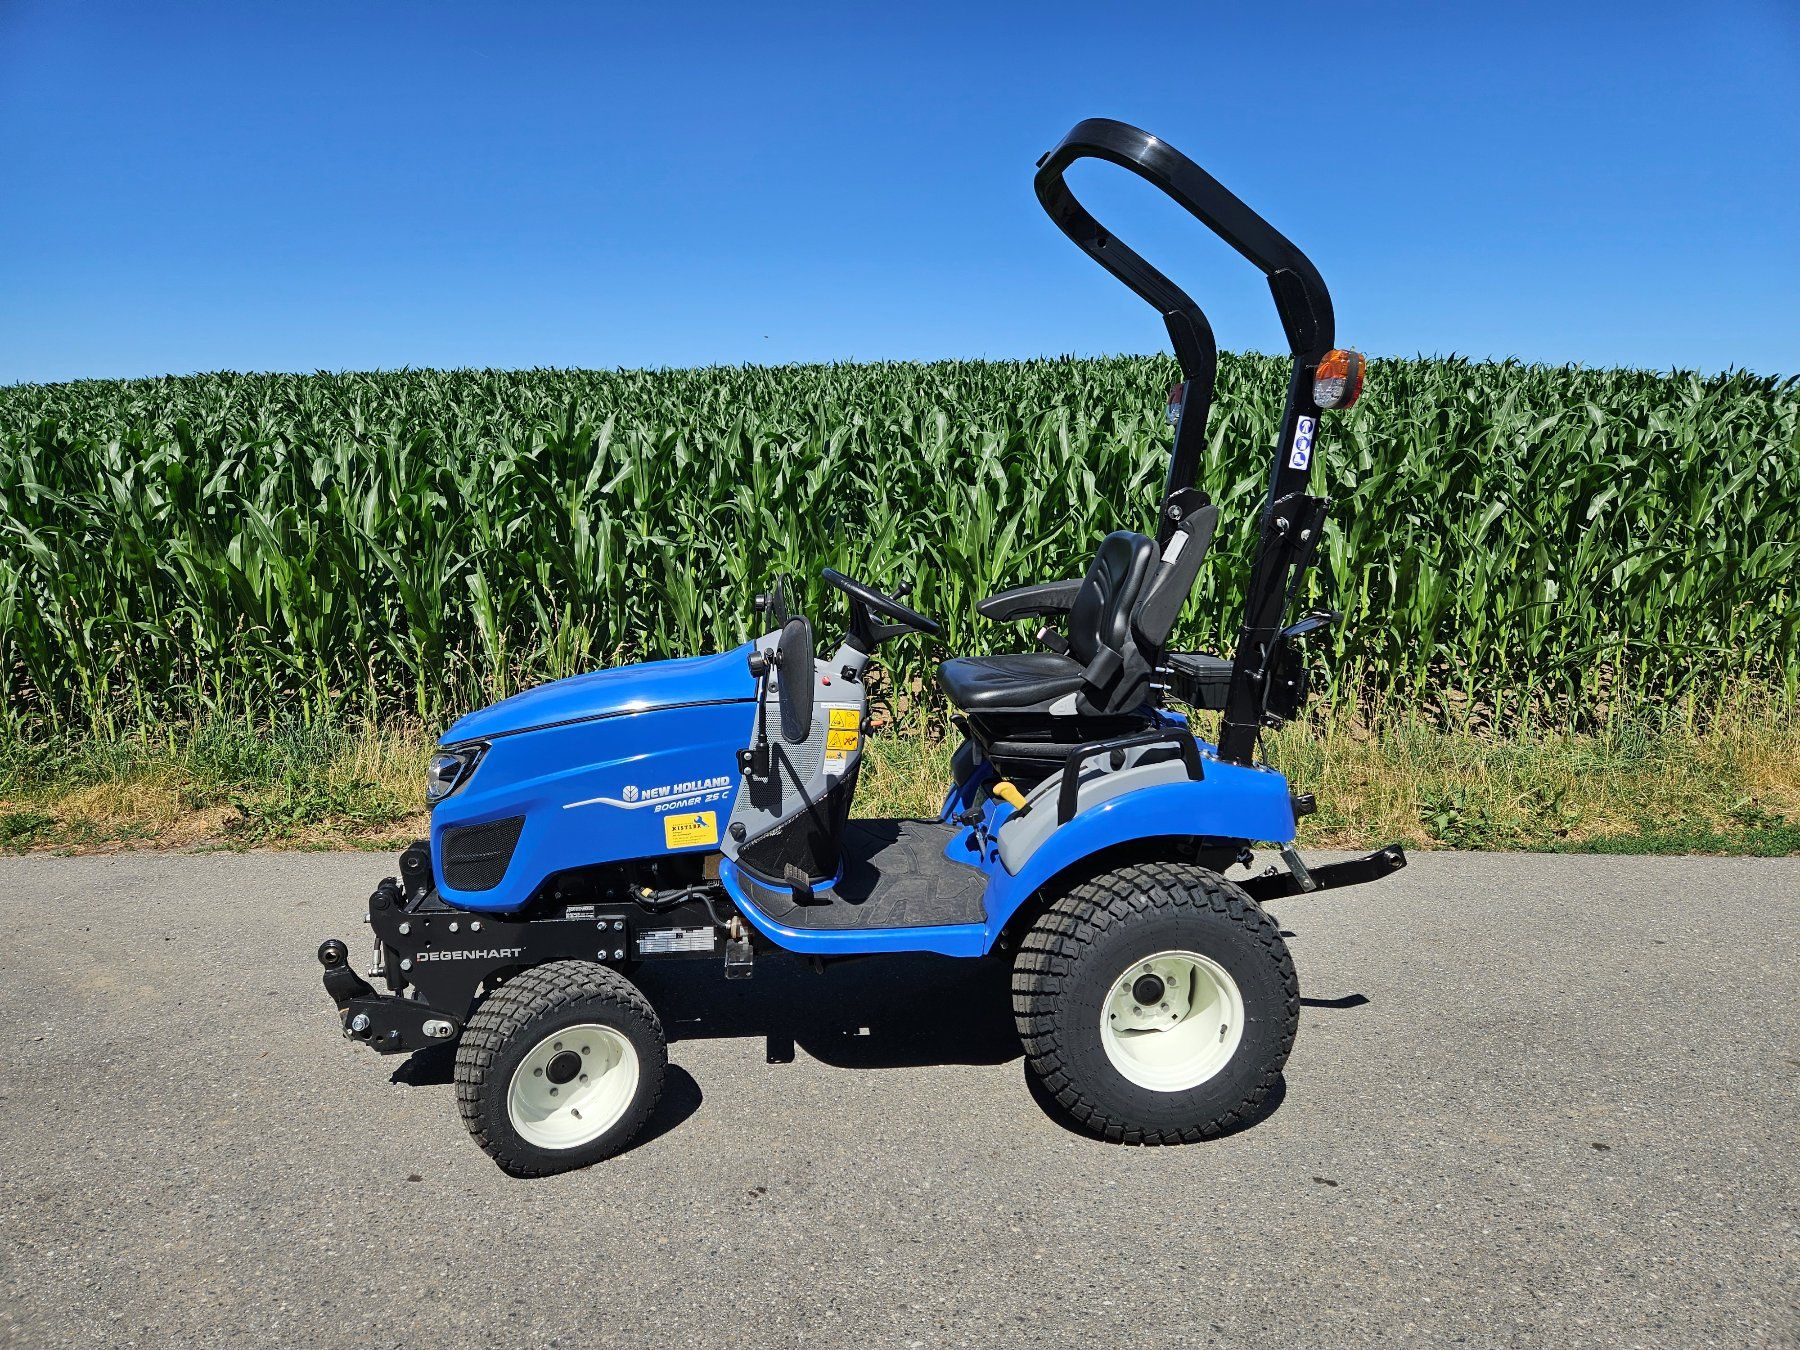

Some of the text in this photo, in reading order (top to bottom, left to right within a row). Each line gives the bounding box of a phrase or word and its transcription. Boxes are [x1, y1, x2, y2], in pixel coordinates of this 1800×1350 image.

[641, 776, 730, 800] NEW HOLLAND
[654, 791, 729, 813] BOOMER 25 C
[416, 948, 521, 962] DEGENHART
